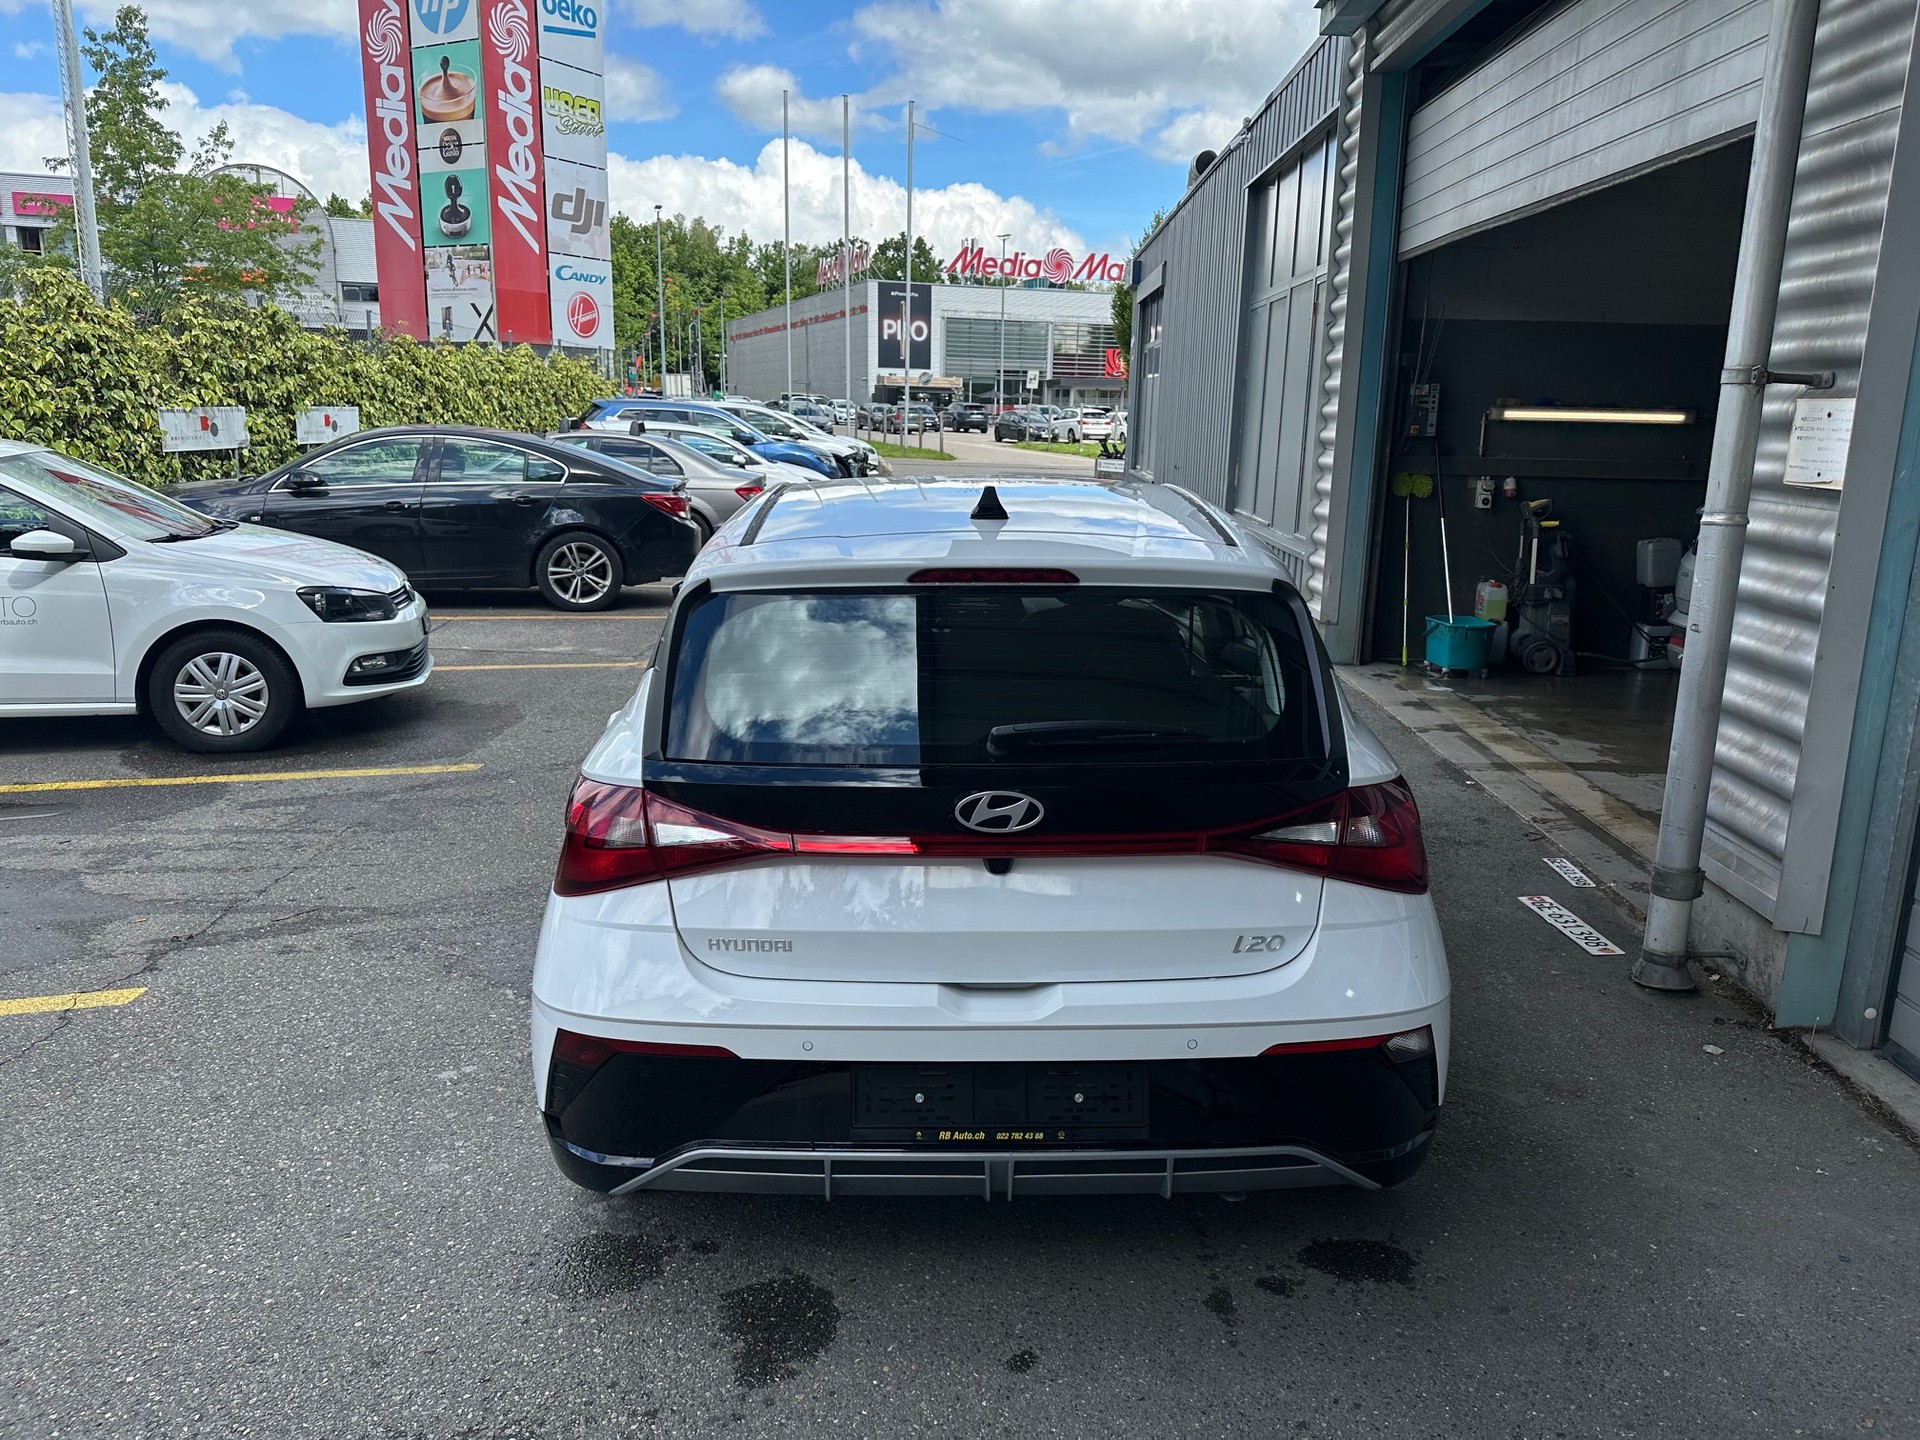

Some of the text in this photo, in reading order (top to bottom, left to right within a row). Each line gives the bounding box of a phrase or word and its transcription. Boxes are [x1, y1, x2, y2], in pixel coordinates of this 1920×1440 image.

[375, 62, 416, 252] Media
[495, 58, 539, 254] Media
[945, 246, 1043, 278] Media
[708, 937, 793, 953] HYUNDAI
[939, 1131, 951, 1140] RB
[952, 1131, 986, 1140] Auto.ch
[996, 1132, 1009, 1140] 022
[1024, 1132, 1034, 1140] 43
